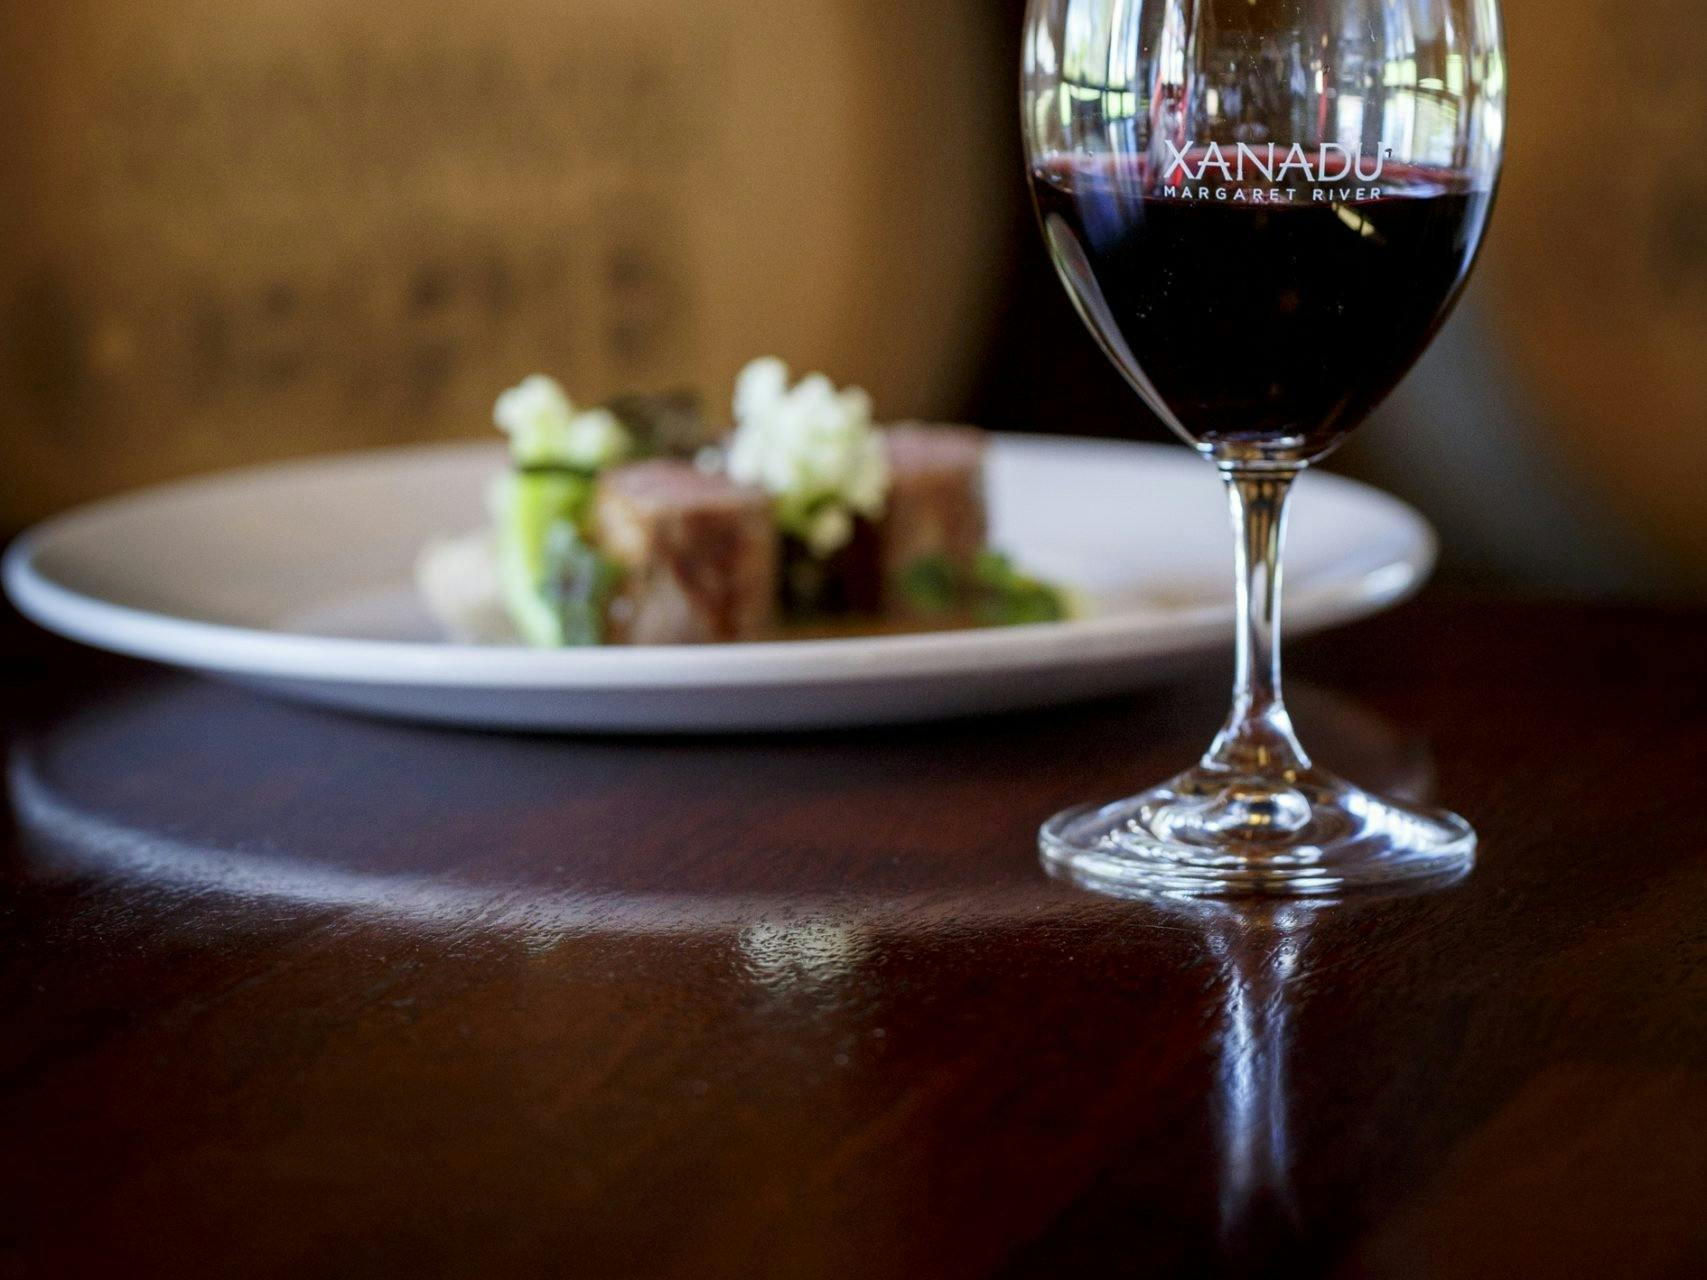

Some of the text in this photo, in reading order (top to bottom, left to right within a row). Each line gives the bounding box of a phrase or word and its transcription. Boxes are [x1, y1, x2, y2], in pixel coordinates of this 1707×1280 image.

[1163, 139, 1385, 183] XANADU
[1163, 185, 1381, 202] MARGARET RIVER
